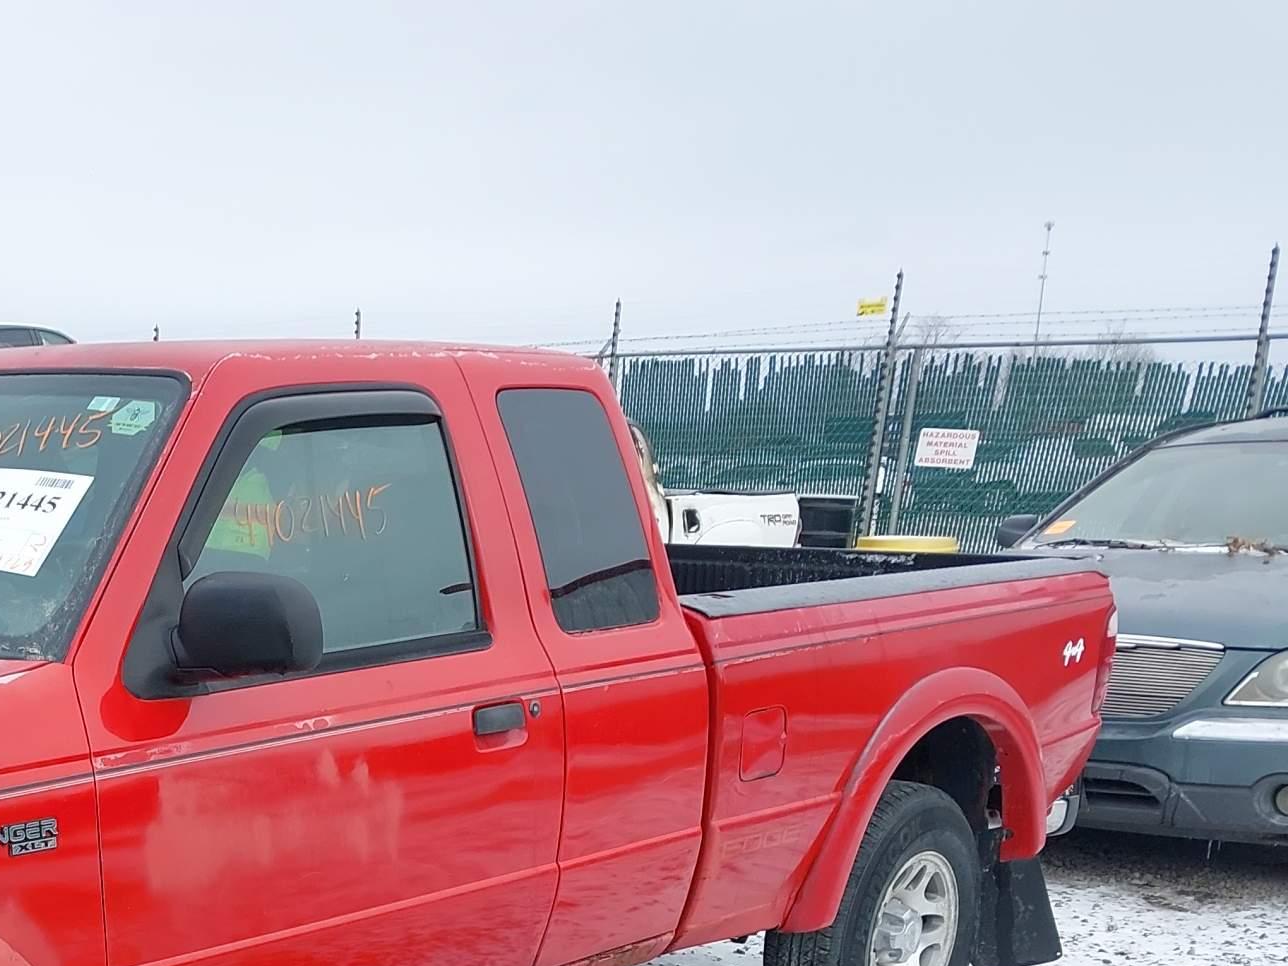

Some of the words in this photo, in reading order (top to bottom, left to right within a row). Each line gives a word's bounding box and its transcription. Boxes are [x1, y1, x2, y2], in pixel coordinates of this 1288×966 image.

[922, 431, 977, 440] HAZARDOUS
[926, 440, 968, 449] MATERIAL
[934, 449, 957, 457] SPILL
[918, 457, 971, 466] ABSORBENT
[233, 483, 392, 547] 44021445
[760, 514, 782, 526] TRD
[15, 839, 56, 854] XLT
